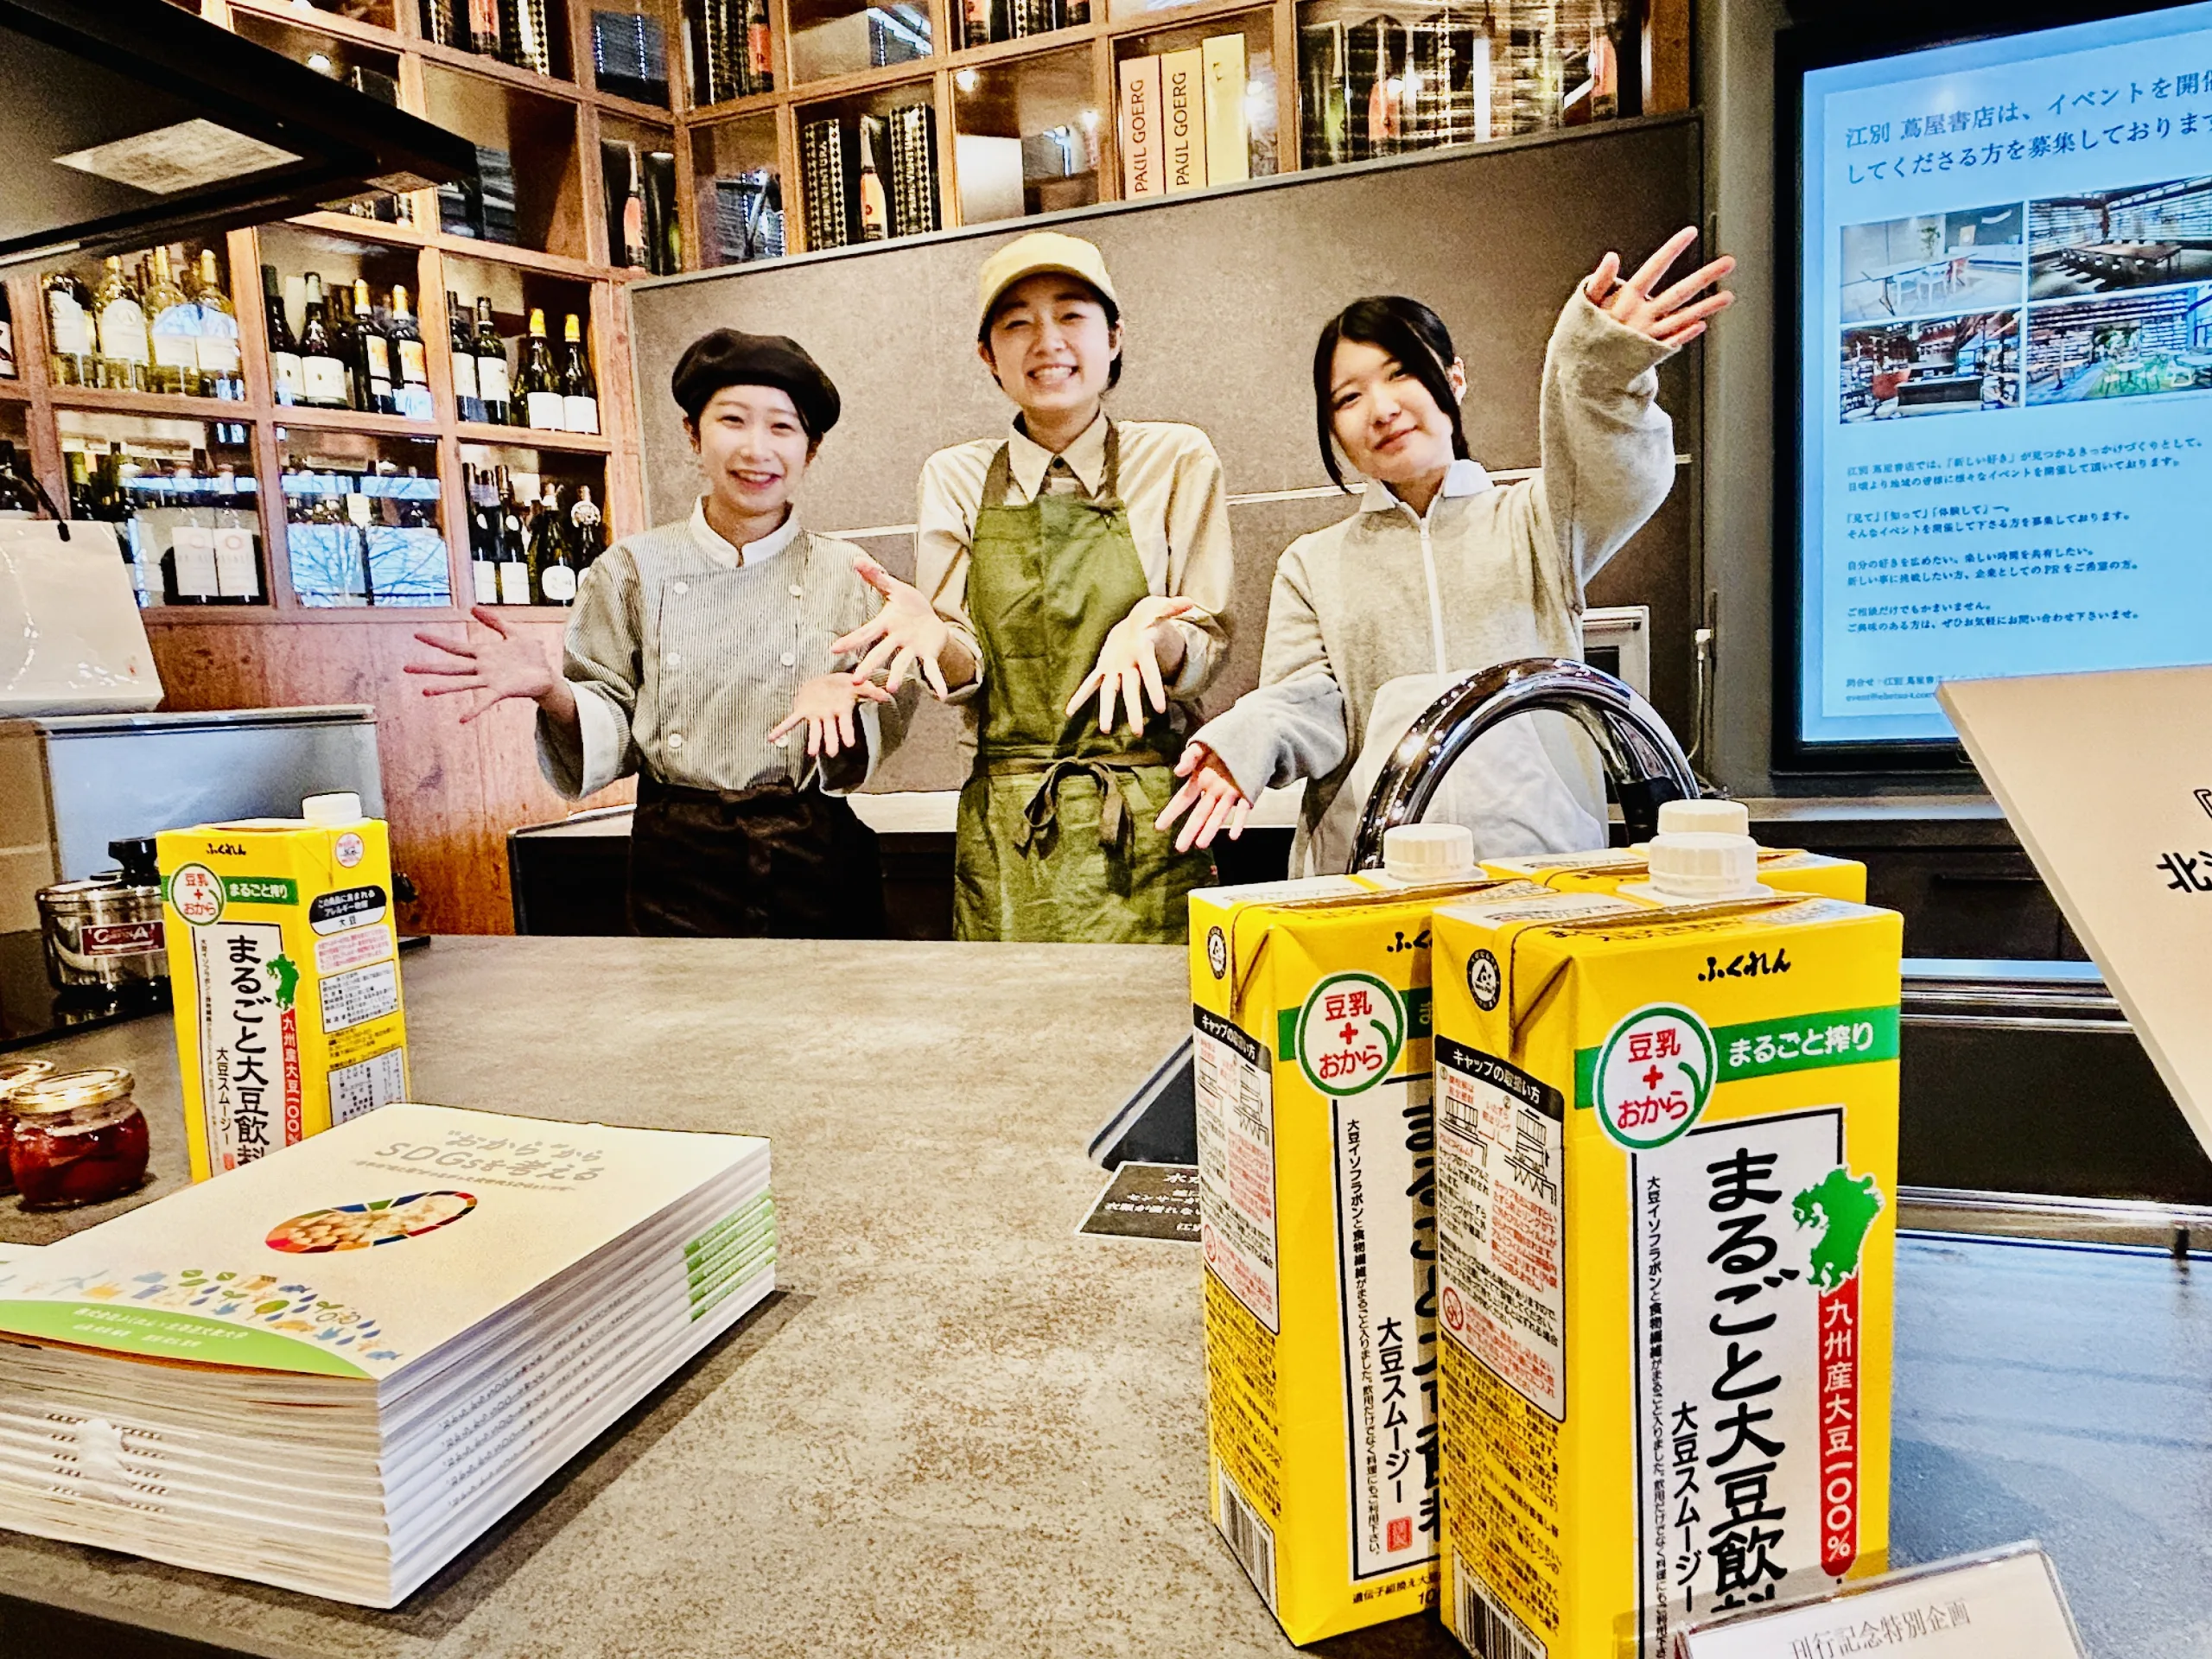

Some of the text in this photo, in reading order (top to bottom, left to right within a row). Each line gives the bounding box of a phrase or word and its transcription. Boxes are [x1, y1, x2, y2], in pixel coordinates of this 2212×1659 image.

[1130, 79, 1148, 193] PAUL GOERG
[1172, 72, 1190, 186] PAUL GOERG
[1846, 122, 1891, 149] 江別
[185, 873, 208, 887] 豆乳
[184, 902, 216, 916] おから
[1698, 949, 1792, 982] ふくれん
[1325, 990, 1373, 1022] 豆乳
[227, 935, 271, 1167] まるごと大豆飲料
[1319, 1045, 1383, 1080] おから
[1628, 1027, 1681, 1064] 豆乳
[1728, 1021, 1874, 1069] まるごと搾り
[216, 1046, 232, 1146] 大豆スムージー
[1452, 1048, 1541, 1104] キャップの取扱い方
[1618, 1090, 1688, 1129] おから
[374, 1141, 605, 1181] SDGsを考える
[1377, 1317, 1411, 1503] 大豆スムージー
[1671, 1401, 1702, 1613] 大豆スムージー
[1789, 1599, 1971, 1659] 刊行記念特別企画
